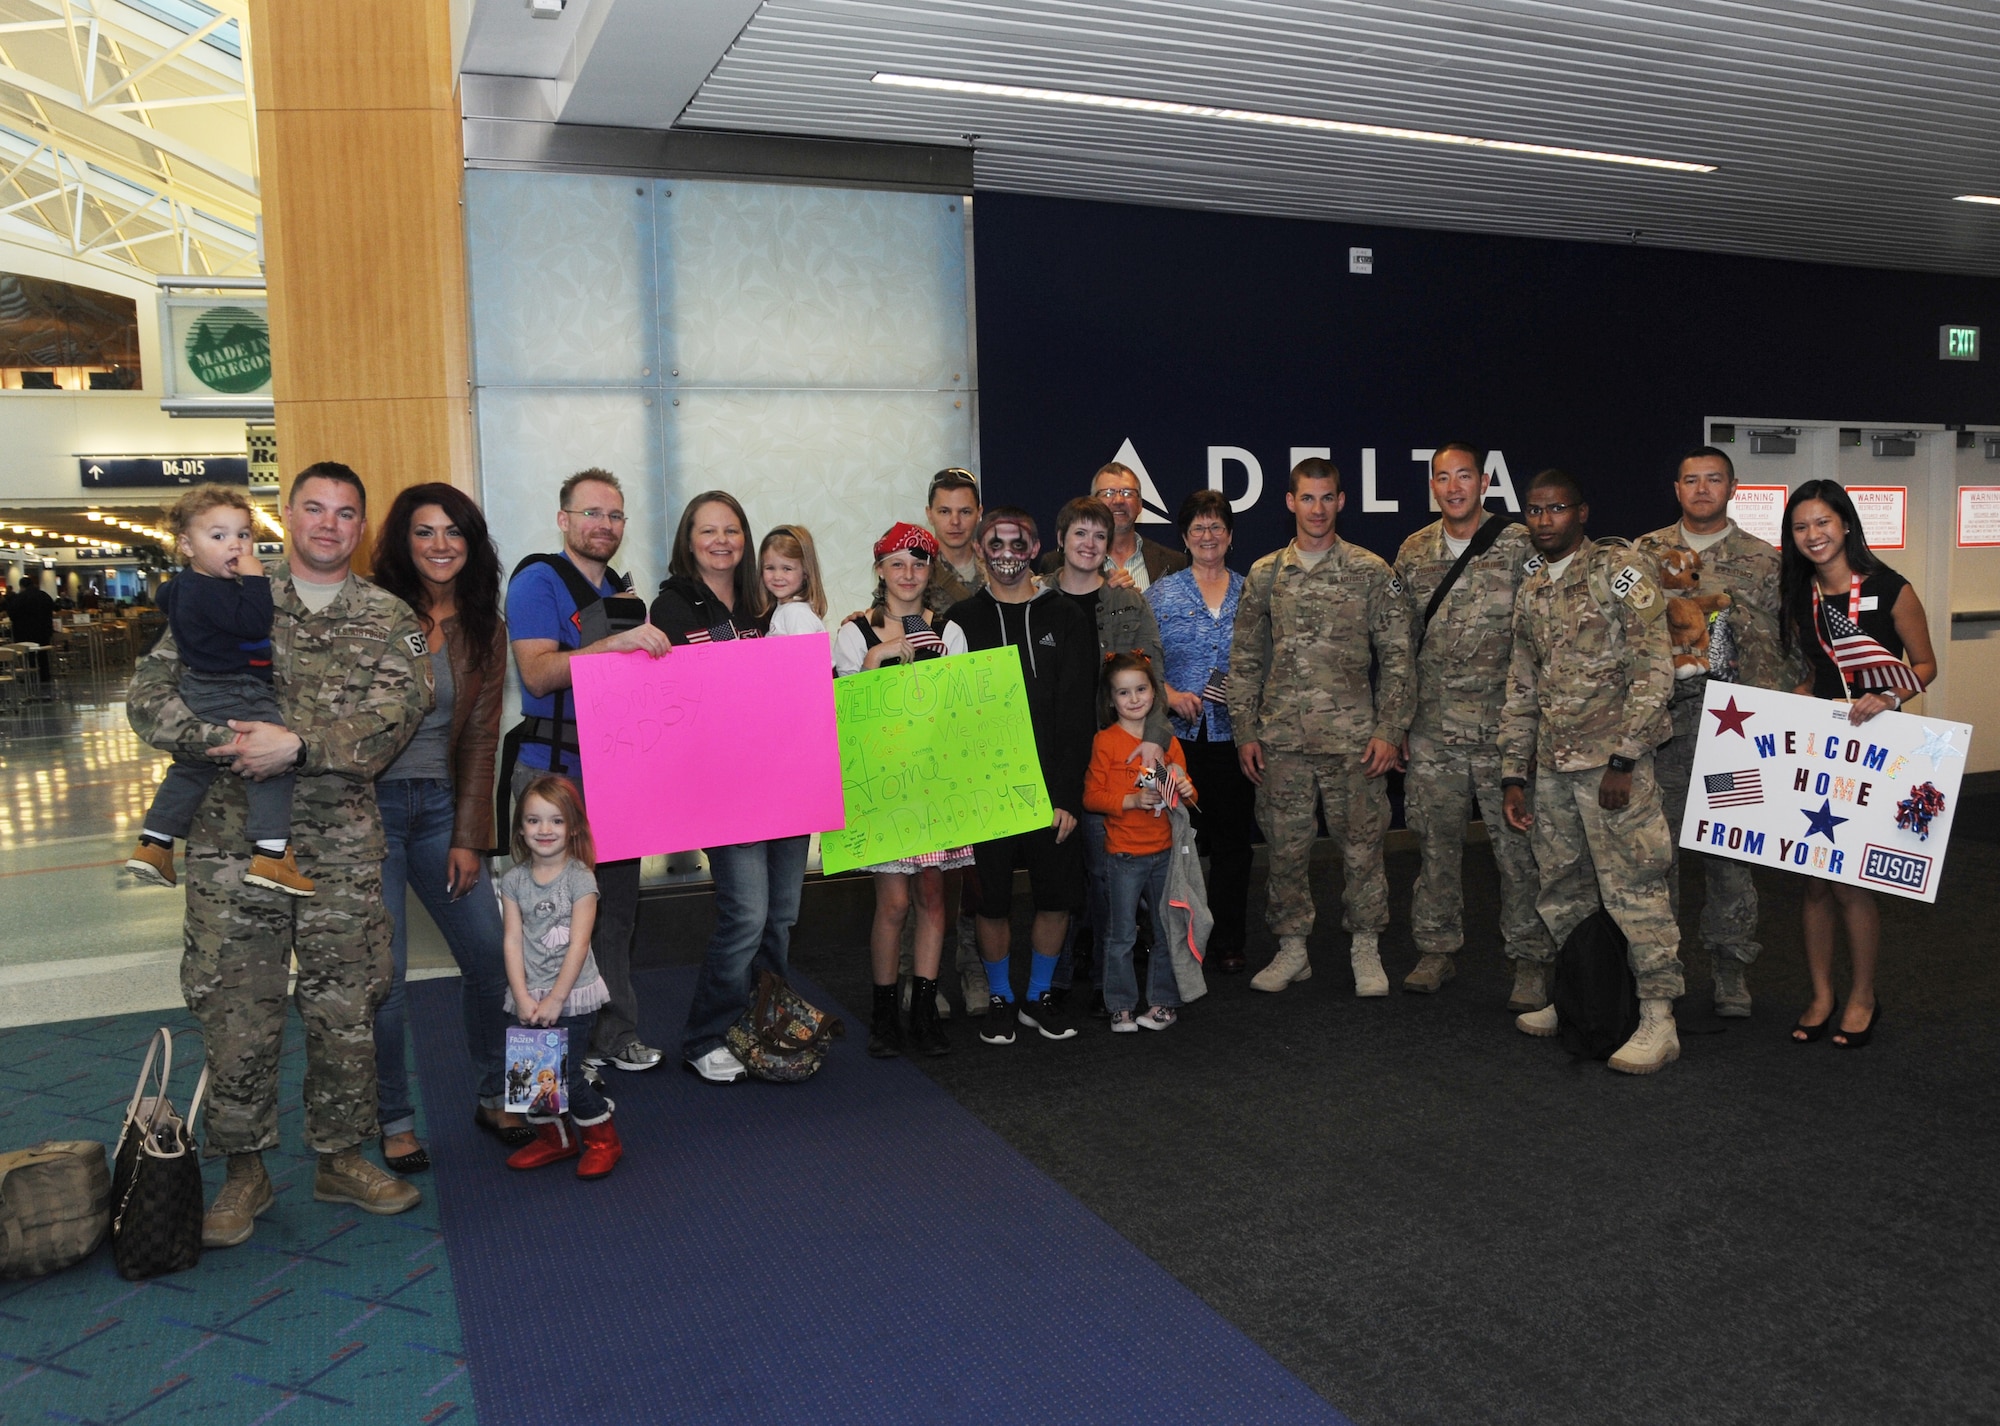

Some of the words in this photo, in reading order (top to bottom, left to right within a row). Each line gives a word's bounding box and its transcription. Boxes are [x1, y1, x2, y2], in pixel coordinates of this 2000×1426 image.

[196, 342, 249, 368] MADE
[1949, 328, 1976, 357] EXIT
[162, 460, 206, 476] D6-D15
[1735, 492, 1775, 502] WARNING
[1857, 493, 1895, 502] WARNING
[1970, 493, 2000, 501] WARNIN
[1614, 568, 1636, 594] SF
[410, 634, 428, 654] SF
[591, 680, 680, 719] HOME
[837, 667, 996, 724] WELCOME
[937, 721, 971, 742] We
[977, 709, 1026, 733] missed
[1755, 731, 1909, 780] WELCOME
[1793, 768, 1872, 807] HOME
[1696, 820, 1766, 855] FROM
[1779, 838, 1845, 875] YOUR
[1876, 854, 1917, 883] USO
[509, 1036, 534, 1044] FROZEN
